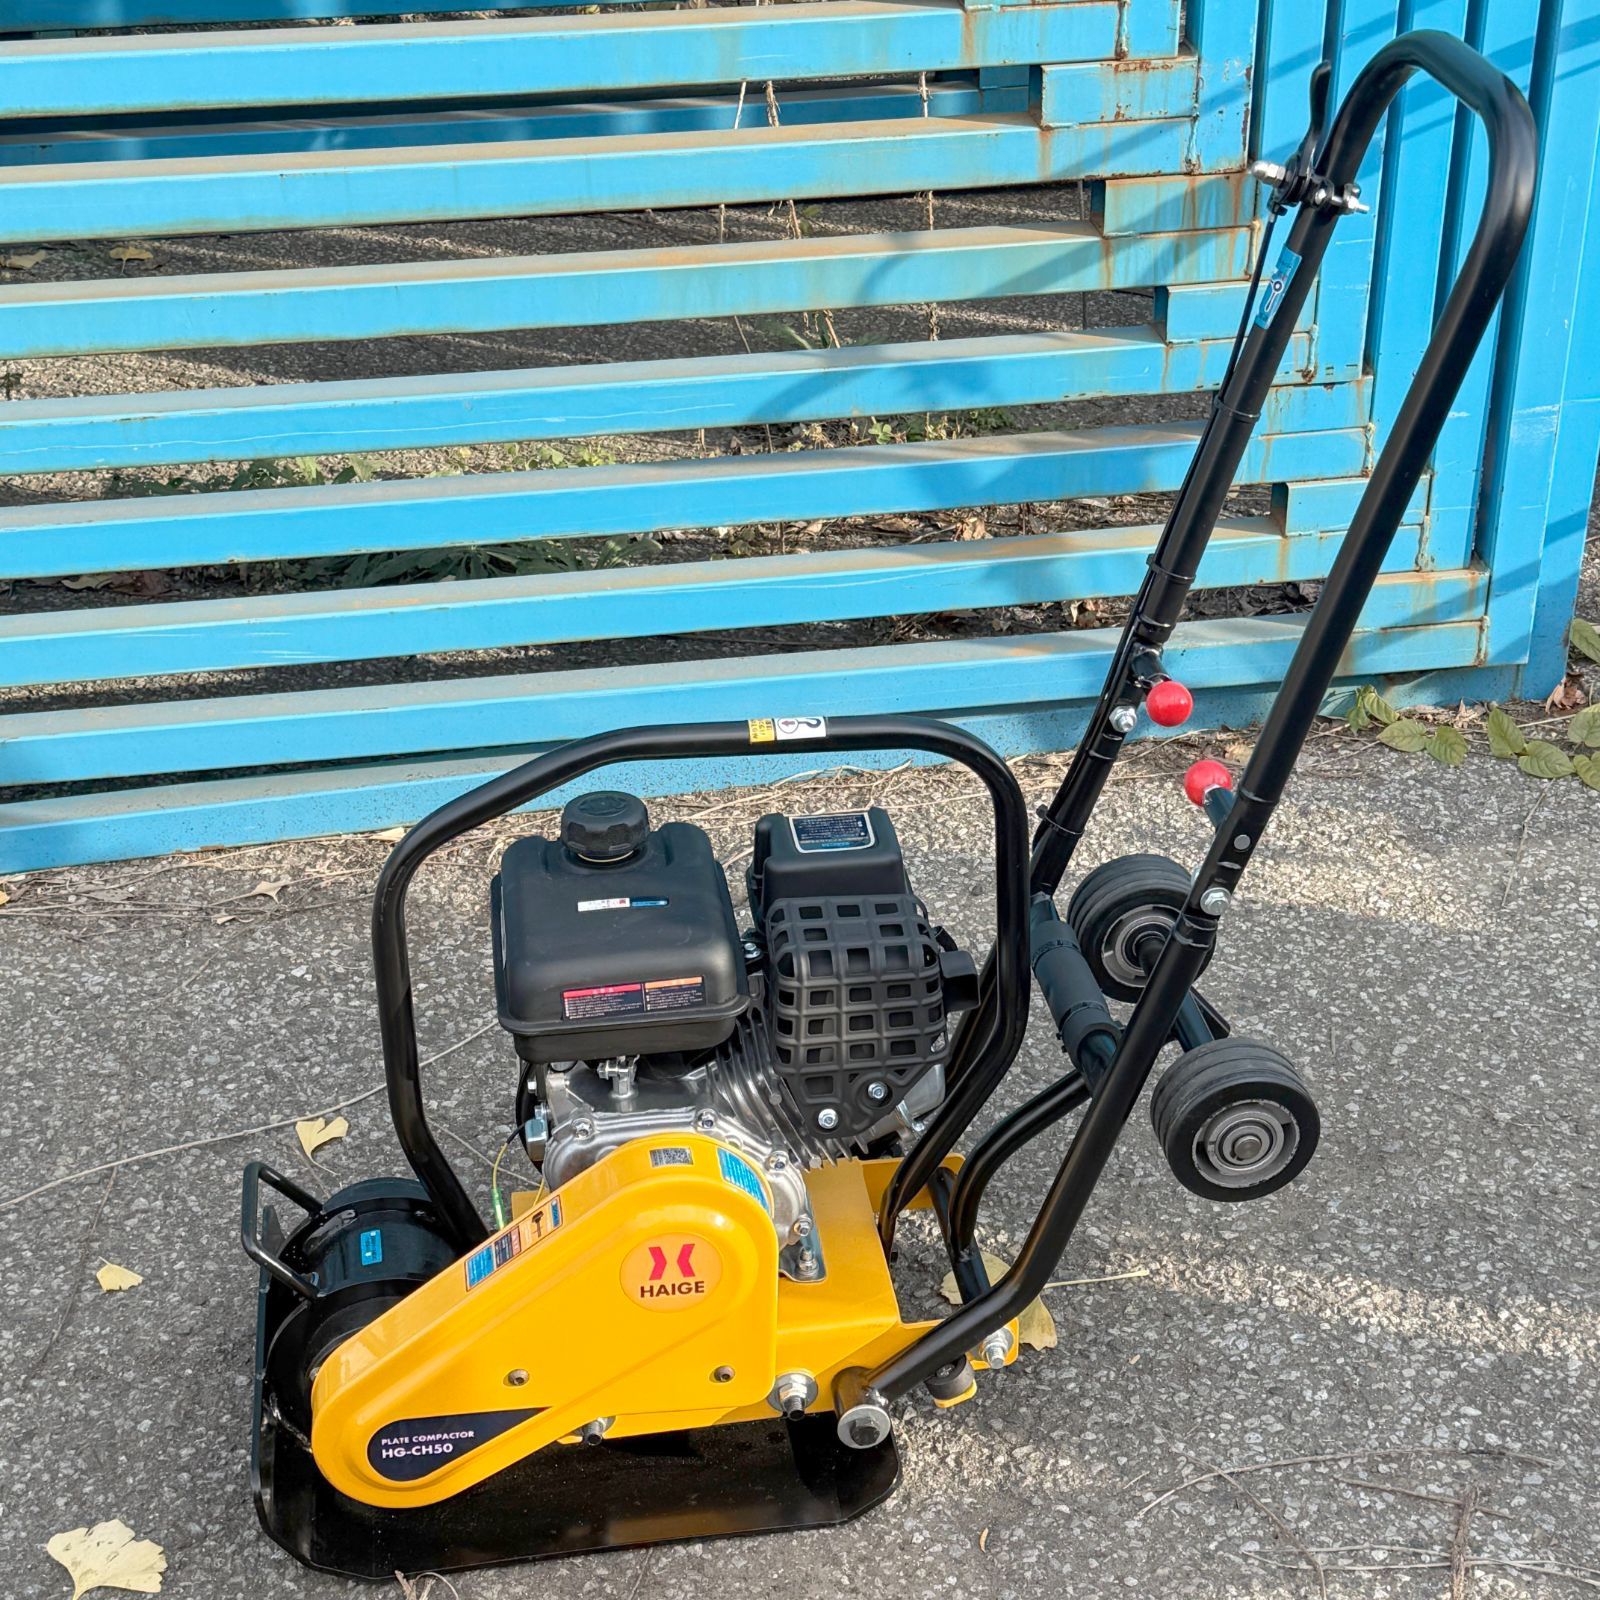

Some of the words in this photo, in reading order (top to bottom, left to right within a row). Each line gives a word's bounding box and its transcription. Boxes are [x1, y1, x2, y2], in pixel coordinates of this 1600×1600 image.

[640, 1281, 704, 1298] HAIGE
[381, 1437, 409, 1445] PLATE
[412, 1431, 475, 1442] COMPACTOR
[382, 1443, 453, 1459] HG-CH50
